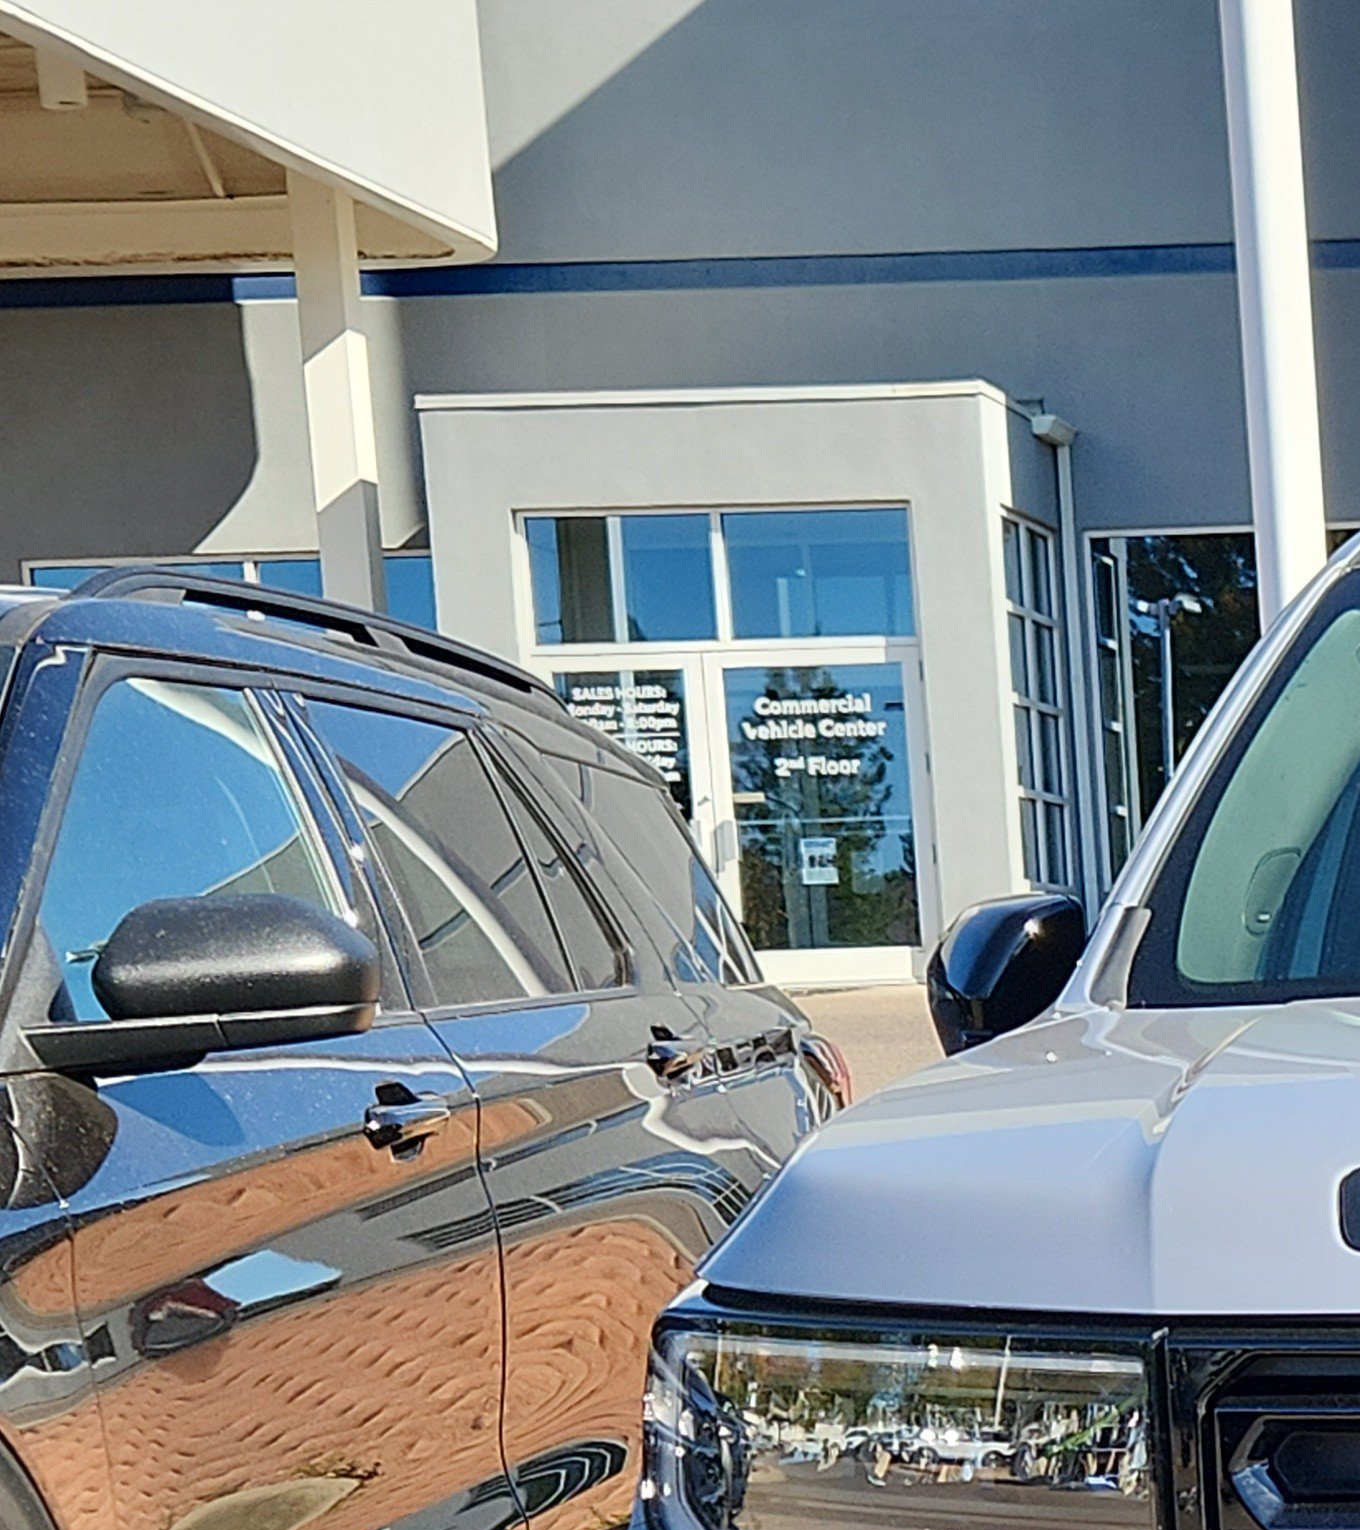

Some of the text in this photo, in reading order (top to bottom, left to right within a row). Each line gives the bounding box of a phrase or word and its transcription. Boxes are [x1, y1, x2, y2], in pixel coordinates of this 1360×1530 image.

[571, 687, 614, 701] SALES
[754, 693, 872, 716] Commercial
[741, 717, 888, 740] Vehicle Center
[774, 756, 861, 777] 2nd Floor
